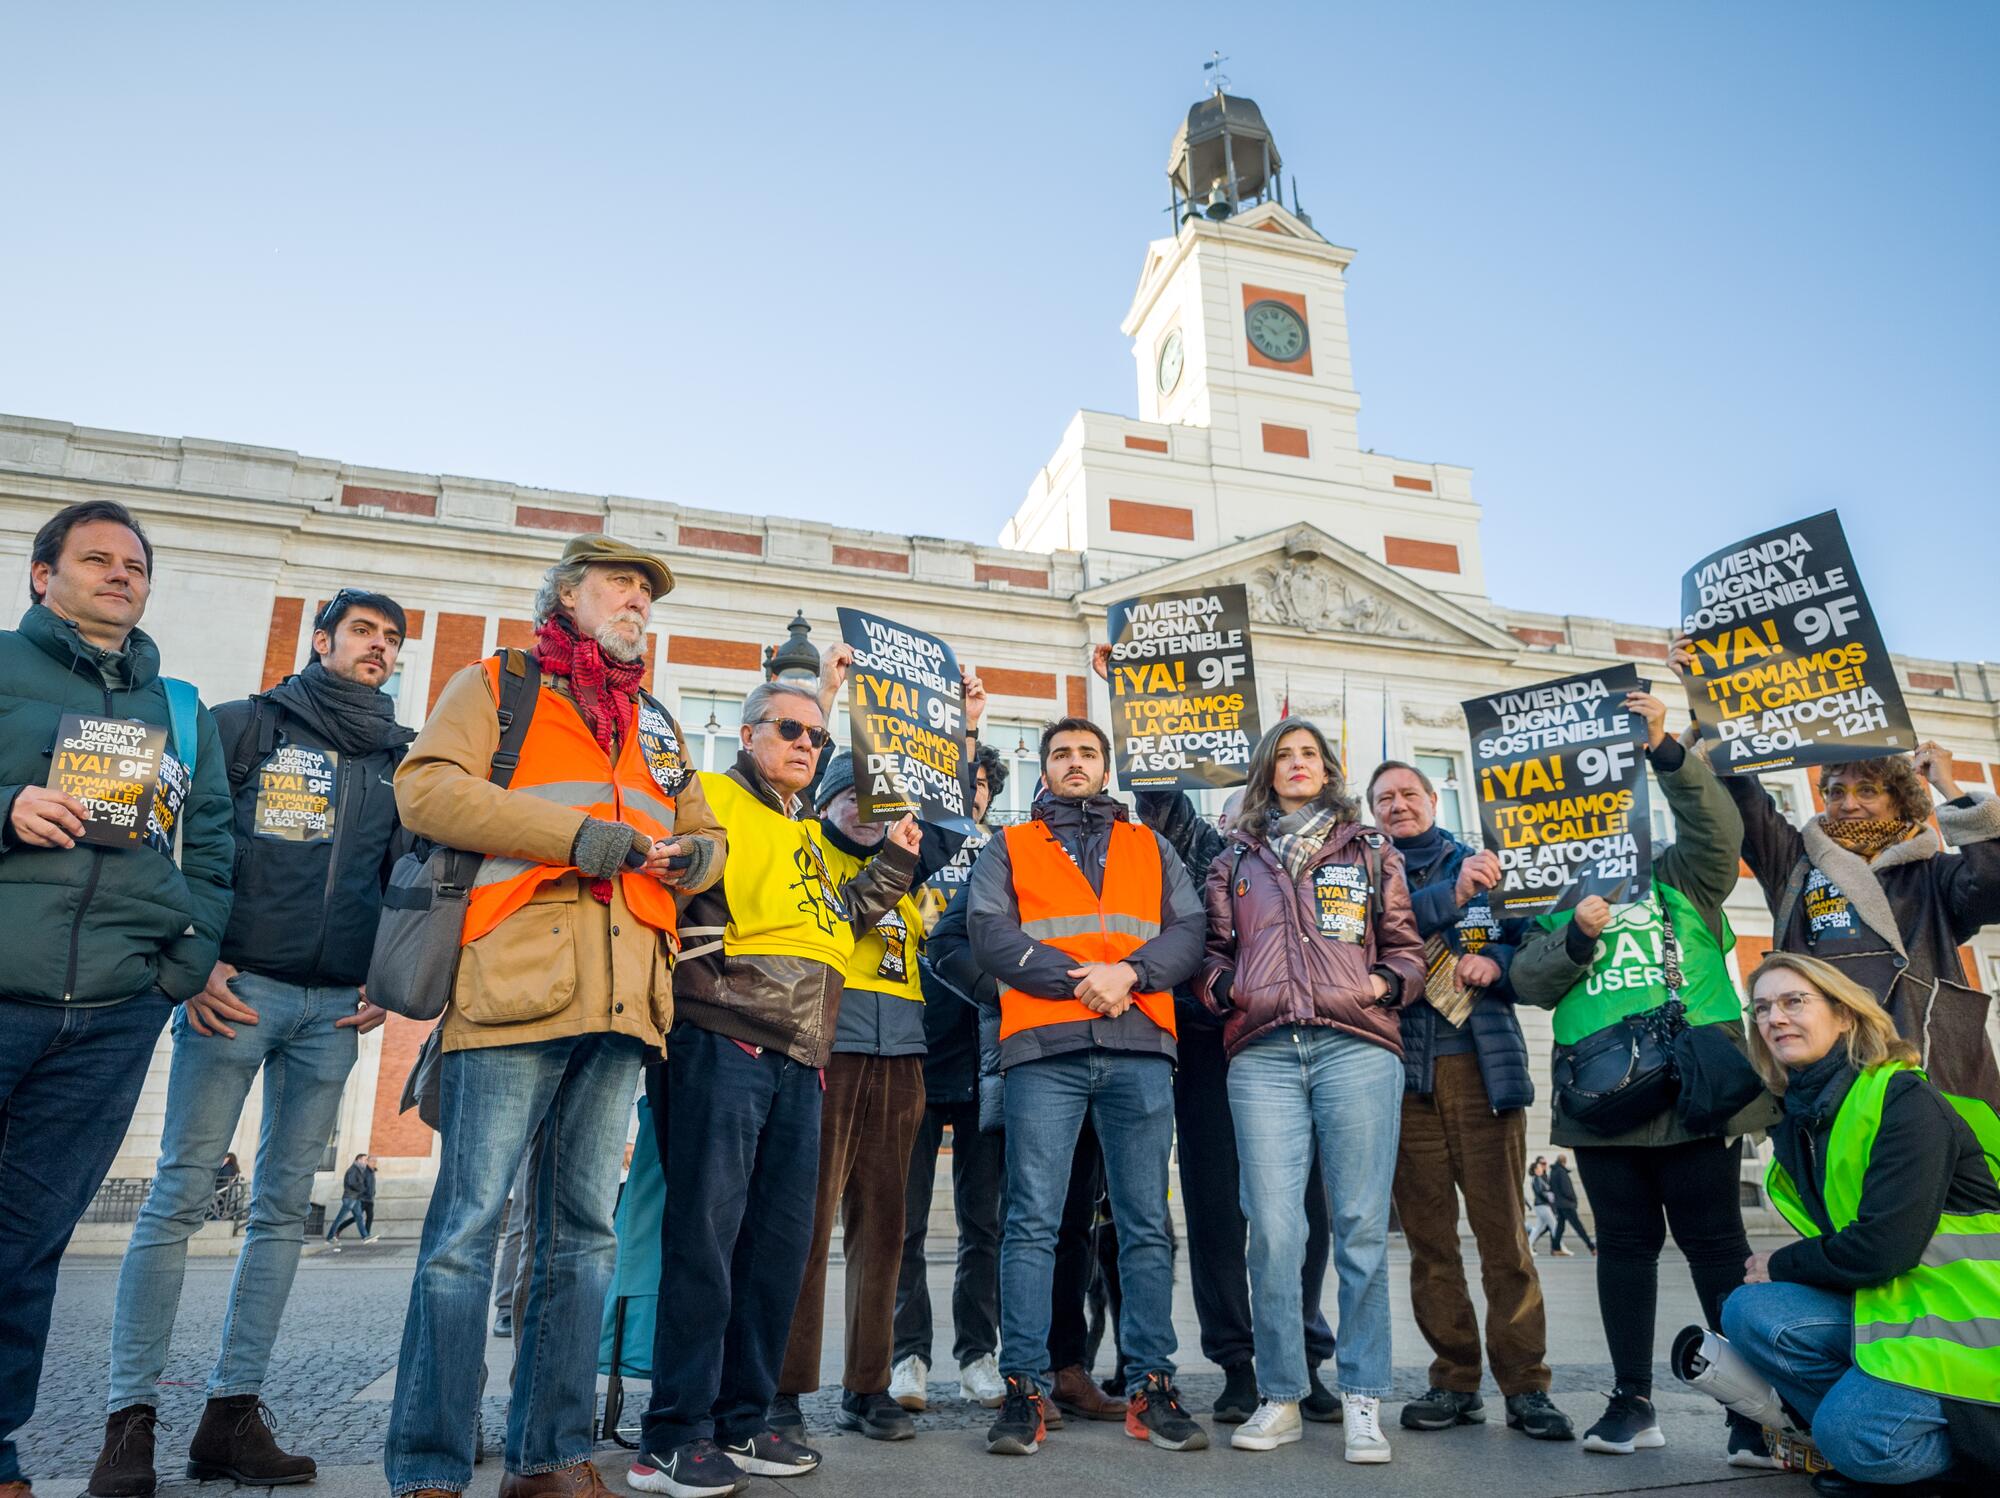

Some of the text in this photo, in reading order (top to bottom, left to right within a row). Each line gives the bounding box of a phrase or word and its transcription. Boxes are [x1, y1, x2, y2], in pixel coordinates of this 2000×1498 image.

[1694, 532, 1812, 588] VIVIENDA
[1700, 555, 1806, 608] DIGNA Y
[1124, 596, 1224, 624] VIVIENDA
[1683, 567, 1848, 635] SOSTENIBLE
[860, 618, 946, 662] VIVIENDA
[1132, 614, 1218, 640] DIGNA Y
[1685, 596, 1860, 676] ¡YA! 9F
[870, 638, 941, 674] DIGNA Y
[1112, 629, 1243, 661] SOSTENIBLE
[853, 649, 960, 700] SOSTENIBLE
[1114, 654, 1246, 696] ¡YA! 9F
[1706, 642, 1868, 702] ¡TOMAMOS
[856, 674, 960, 734] ¡YA! 9F
[1124, 694, 1244, 720] ¡TOMAMOS
[1488, 679, 1609, 715] VIVIENDA
[1719, 666, 1866, 719] LA CALLE!
[80, 720, 146, 738] VIVIENDA
[1131, 712, 1240, 736] LA CALLE!
[1502, 700, 1601, 735] DIGNA Y
[1717, 686, 1885, 742] DE ATOCHA
[63, 738, 154, 760] SOSTENIBLE
[81, 730, 142, 746] DIGNA Y
[866, 714, 960, 760] ¡TOMAMOS
[1126, 730, 1250, 754] DE ATOCHA
[1479, 714, 1630, 759] SOSTENIBLE
[1730, 740, 1753, 760] A
[1751, 727, 1814, 755] SOL
[1834, 707, 1888, 738] 12H
[58, 752, 152, 779] ¡YA! 9F
[266, 764, 332, 779] SOSTENIBLE
[276, 748, 324, 762] VIVIENDA
[279, 757, 312, 768] DIGNA
[874, 734, 956, 778] LA CALLE!
[1130, 755, 1148, 772] A
[1149, 752, 1194, 770] SOL
[1210, 746, 1250, 766] 12H
[1481, 742, 1634, 802] ¡YA! 9F
[60, 774, 144, 794] ¡TOMAMOS
[264, 775, 332, 794] ¡YA! 9F
[868, 754, 964, 799] DE ATOCHA
[84, 787, 138, 804] CALLE!
[267, 792, 328, 805] ¡TOMAMOS
[269, 800, 325, 812] LA CALLE!
[872, 775, 891, 795] A
[892, 774, 931, 800] SOL
[940, 792, 964, 816] 12H
[1495, 790, 1634, 829] ¡TOMAMOS
[110, 814, 136, 827] 12H
[264, 809, 326, 822] DE ATOCHA
[275, 818, 297, 827] SOL
[307, 821, 325, 830] 12H
[1502, 812, 1628, 848] LA CALLE!
[1499, 834, 1638, 870] DE ATOCHA
[1504, 872, 1524, 892] A
[1524, 866, 1578, 888] SOL
[1596, 855, 1638, 879] 12H
[1318, 886, 1348, 899] ¡YA!
